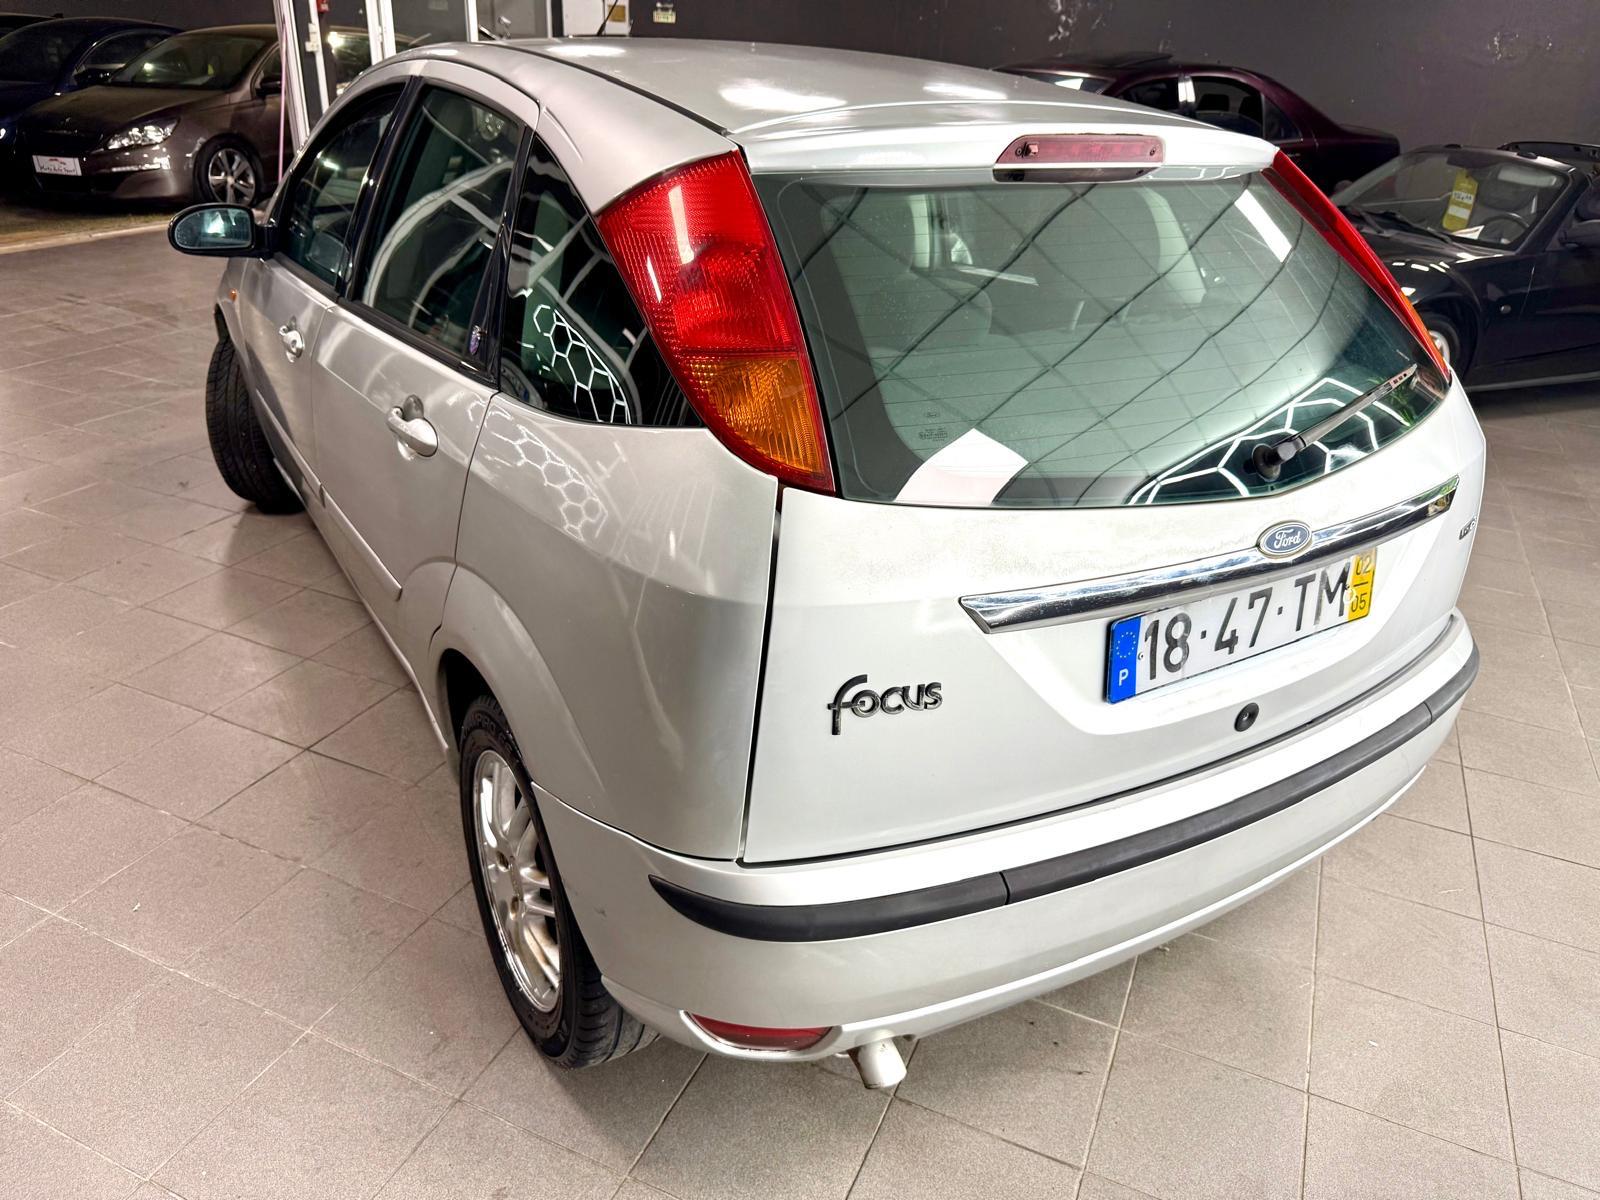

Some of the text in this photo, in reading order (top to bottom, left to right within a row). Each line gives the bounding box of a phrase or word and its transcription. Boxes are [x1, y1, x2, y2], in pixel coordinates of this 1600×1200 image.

[1273, 528, 1301, 549] Ford
[1356, 555, 1371, 576] 02
[1351, 593, 1368, 613] 05
[1118, 668, 1129, 687] P
